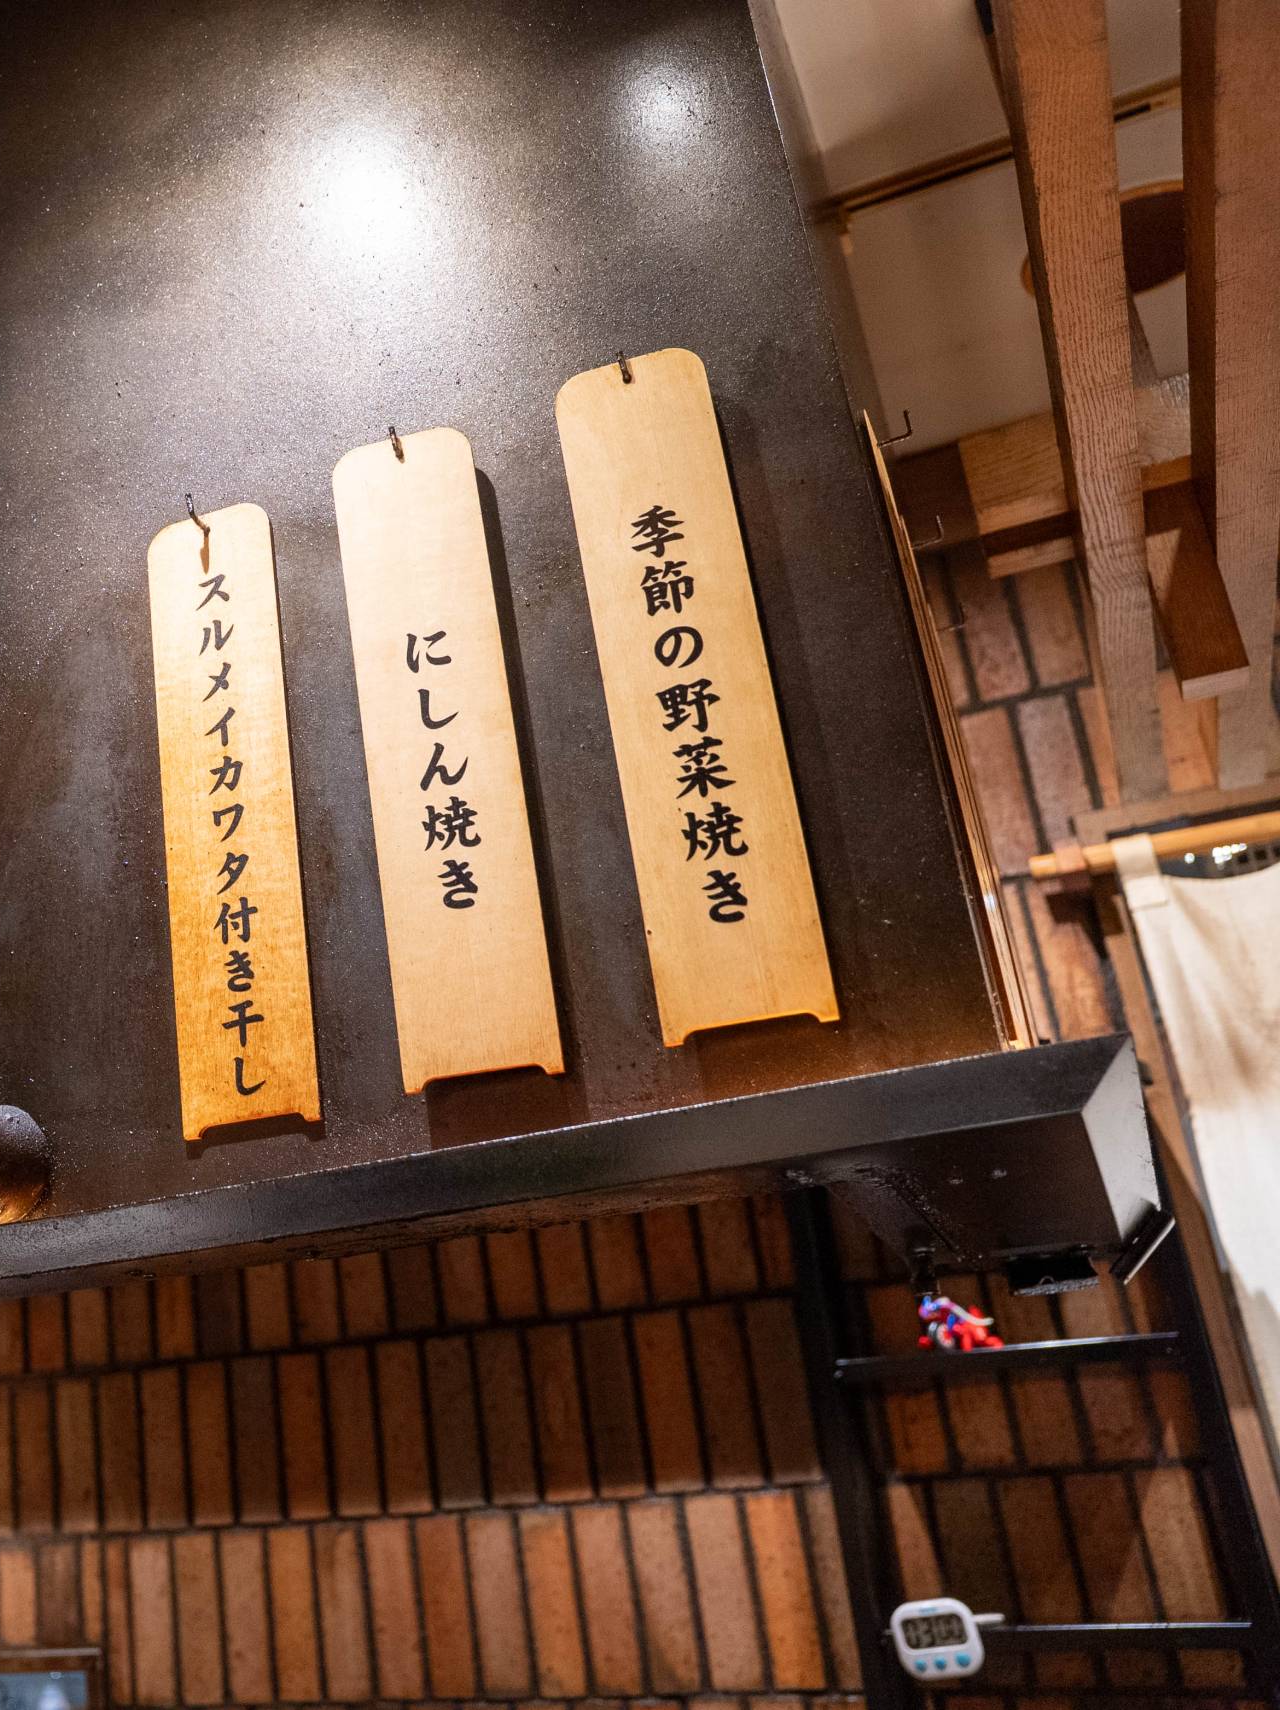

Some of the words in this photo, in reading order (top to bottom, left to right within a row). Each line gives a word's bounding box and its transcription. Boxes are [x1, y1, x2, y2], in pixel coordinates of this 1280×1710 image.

[197, 573, 266, 1097] スルメイカワタ付き干し
[405, 629, 482, 911] にしん焼き
[631, 504, 751, 924] 季節の野菜焼き
